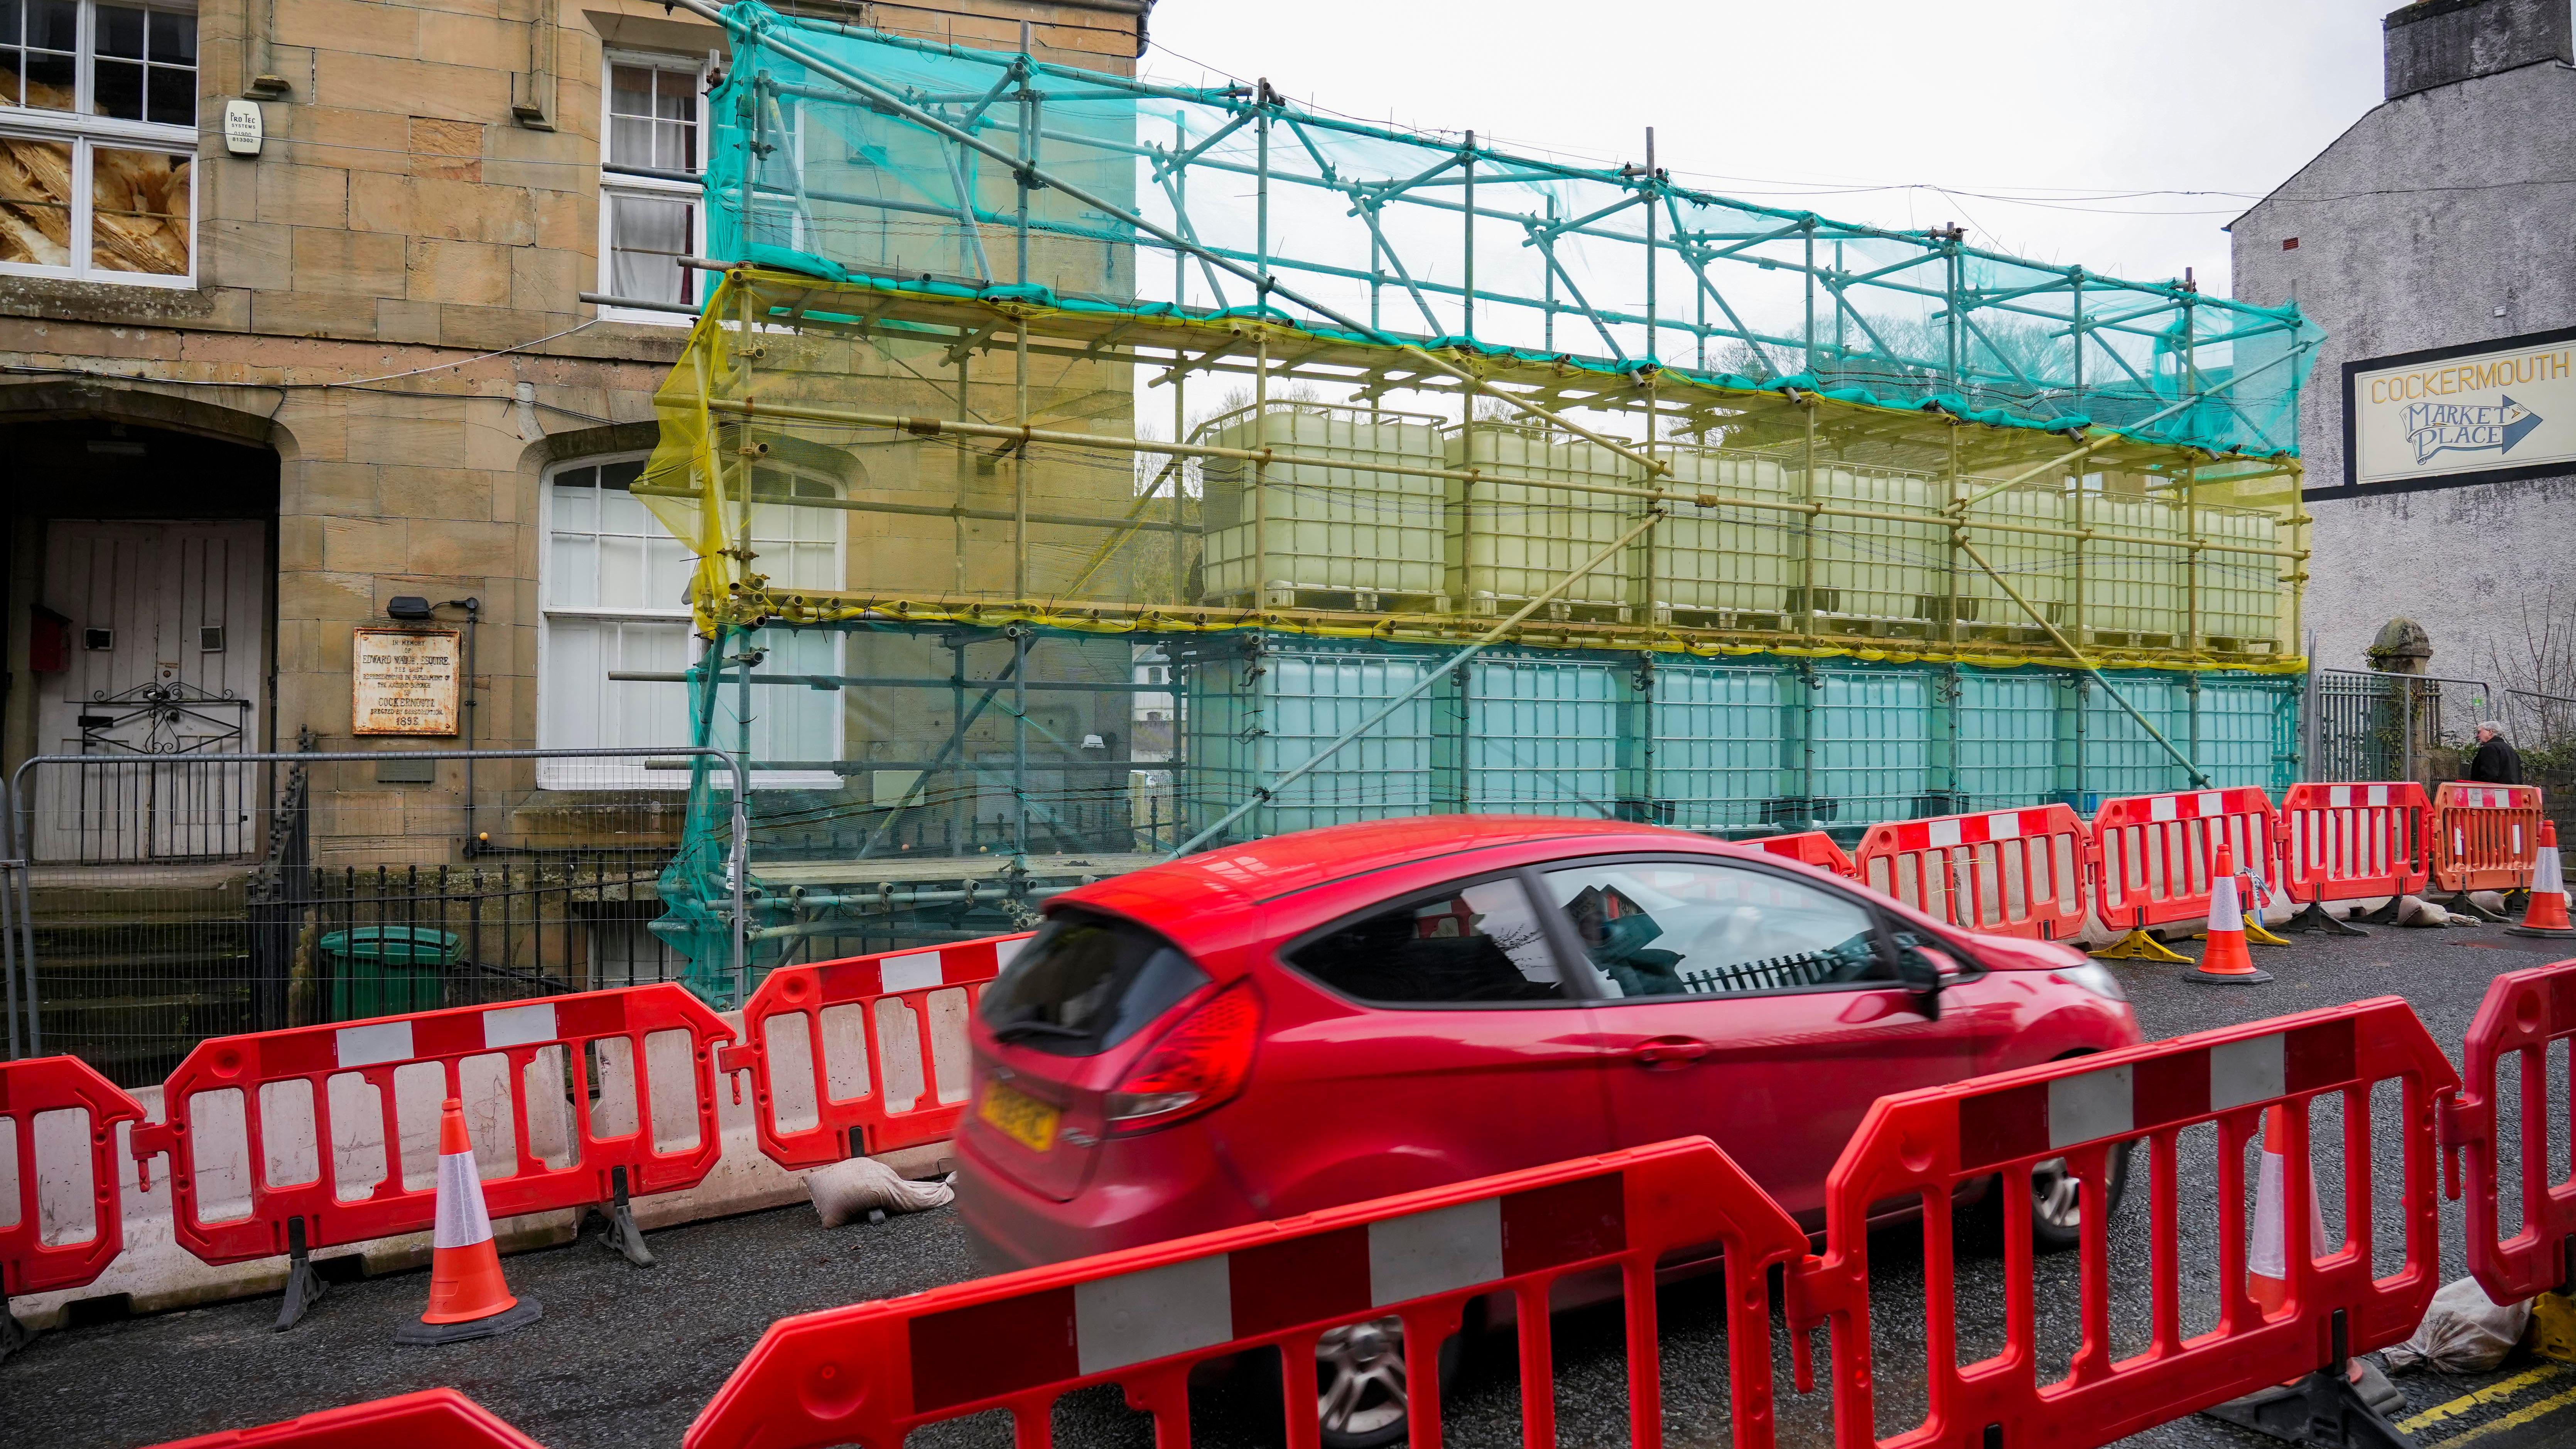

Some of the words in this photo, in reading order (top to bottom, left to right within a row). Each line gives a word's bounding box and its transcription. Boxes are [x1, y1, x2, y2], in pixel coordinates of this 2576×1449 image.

[2372, 351, 2570, 404] COCKERMOUTH
[2407, 404, 2509, 432] MARKET
[2417, 426, 2502, 459] PLACE
[363, 655, 391, 664] EDWARD
[378, 697, 435, 707] COCKERMOUTH
